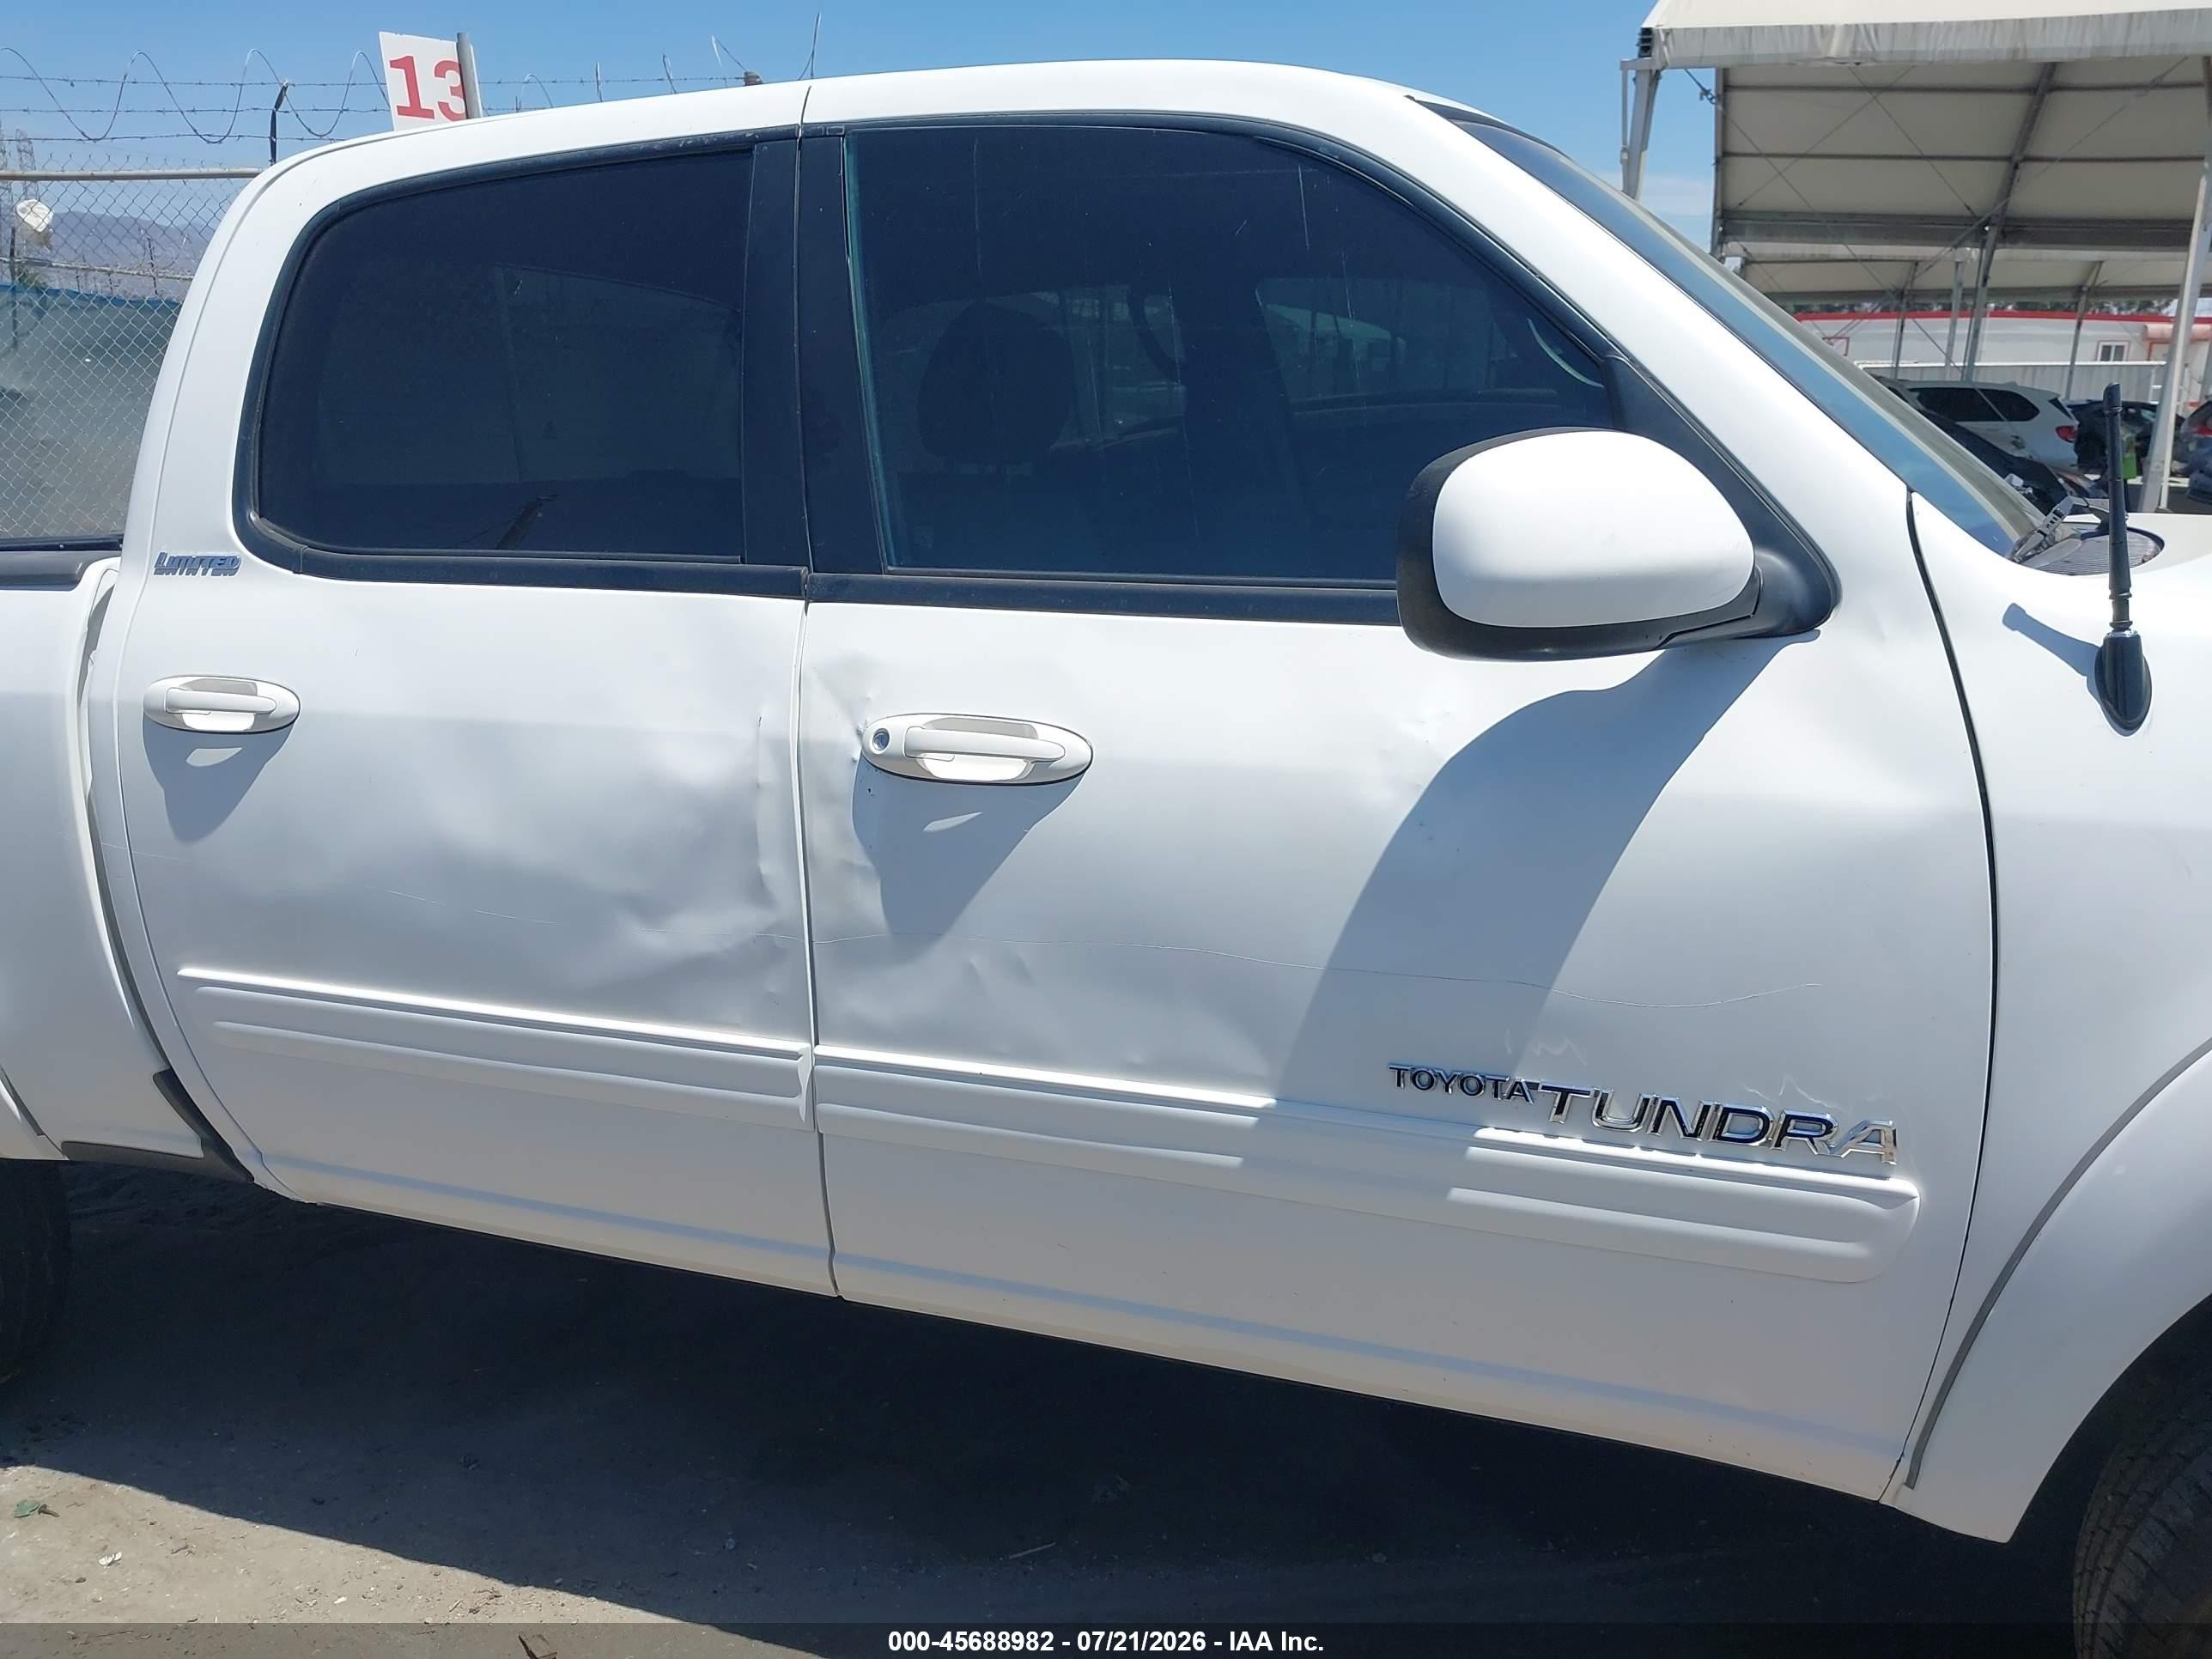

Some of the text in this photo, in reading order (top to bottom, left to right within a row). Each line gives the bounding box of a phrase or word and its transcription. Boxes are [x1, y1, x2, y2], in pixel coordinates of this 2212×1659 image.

[389, 55, 468, 122] 13
[154, 552, 241, 576] LIMITED
[1389, 1064, 1898, 1166] TOYOTA TUNDRA
